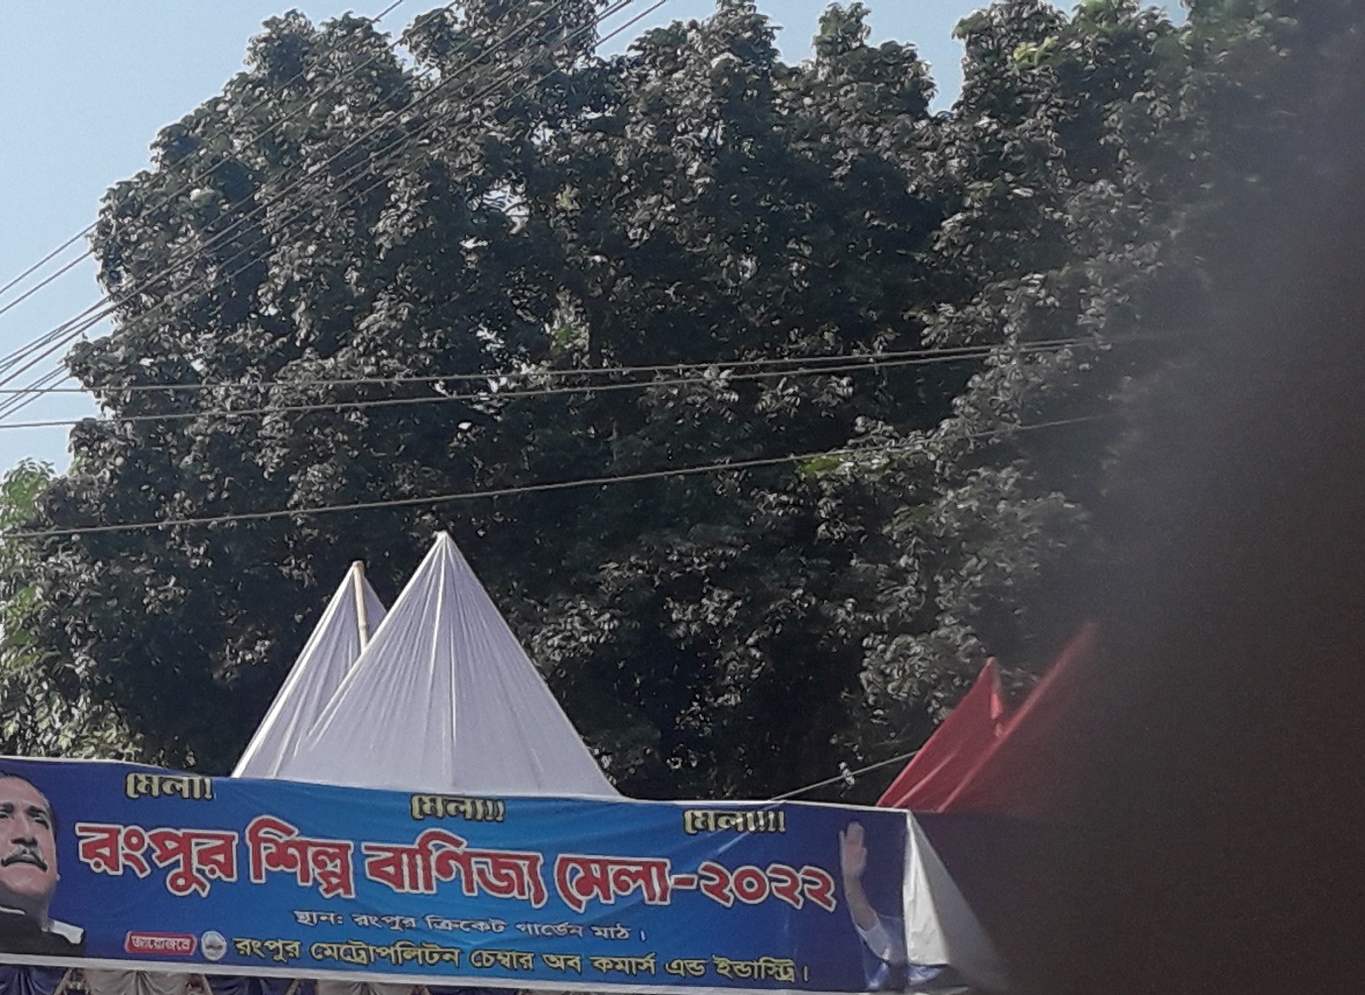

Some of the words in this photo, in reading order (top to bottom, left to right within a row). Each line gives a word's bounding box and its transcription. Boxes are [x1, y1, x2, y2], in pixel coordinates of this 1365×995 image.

[75, 821, 238, 898] রংপুর
[245, 814, 356, 899] শিল্প
[362, 828, 545, 909] বাণিজ্য
[554, 852, 837, 914] মেলা-২০২২
[352, 912, 416, 935] রংপুর
[426, 911, 506, 936] ক্রিকেট
[516, 916, 585, 941] গার্ডেন
[233, 936, 302, 963] রংপুর
[309, 936, 459, 968] মেট্রোপলিটন
[469, 947, 535, 973] চেম্বার
[542, 951, 582, 976] অব
[592, 952, 657, 978] কমার্স
[663, 956, 709, 980] এন্ড
